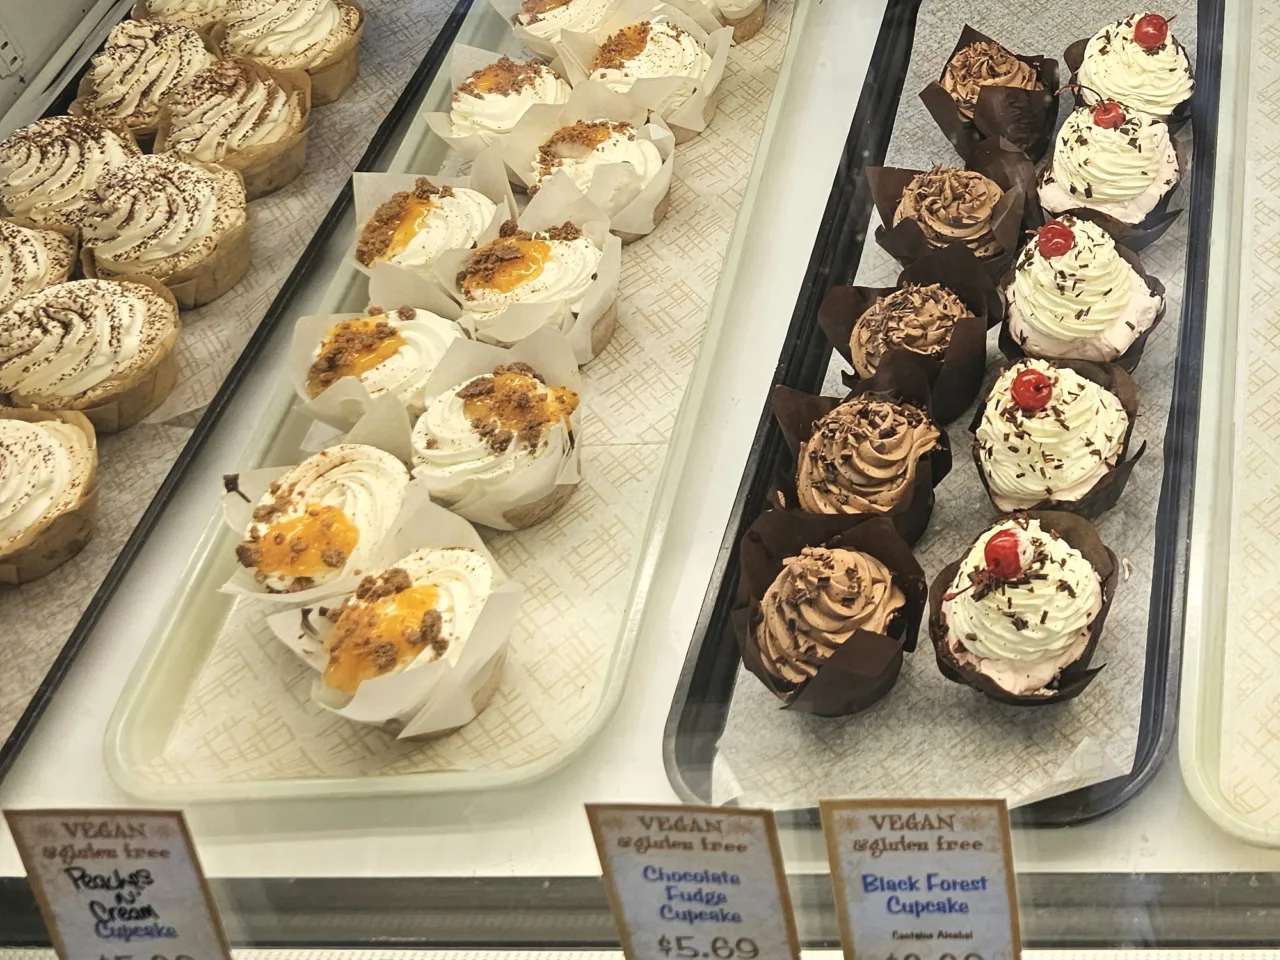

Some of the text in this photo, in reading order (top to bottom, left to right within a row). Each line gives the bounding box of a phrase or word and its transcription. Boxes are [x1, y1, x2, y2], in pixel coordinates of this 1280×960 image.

[60, 821, 147, 839] VEGAN
[638, 815, 723, 833] VEGAN
[868, 813, 956, 832] VEGAN
[123, 842, 171, 859] free
[701, 836, 748, 853] free
[936, 836, 984, 852] free
[642, 865, 741, 886] Chocolate
[861, 873, 989, 893] Black Forest
[665, 886, 728, 906] Fudge
[89, 900, 160, 922] Cream
[659, 904, 743, 925] Cupcake
[886, 895, 970, 918] Cupcake
[95, 920, 179, 942] Cupcake
[892, 929, 973, 940] Contains Alcohol
[658, 933, 760, 960] $5.69
